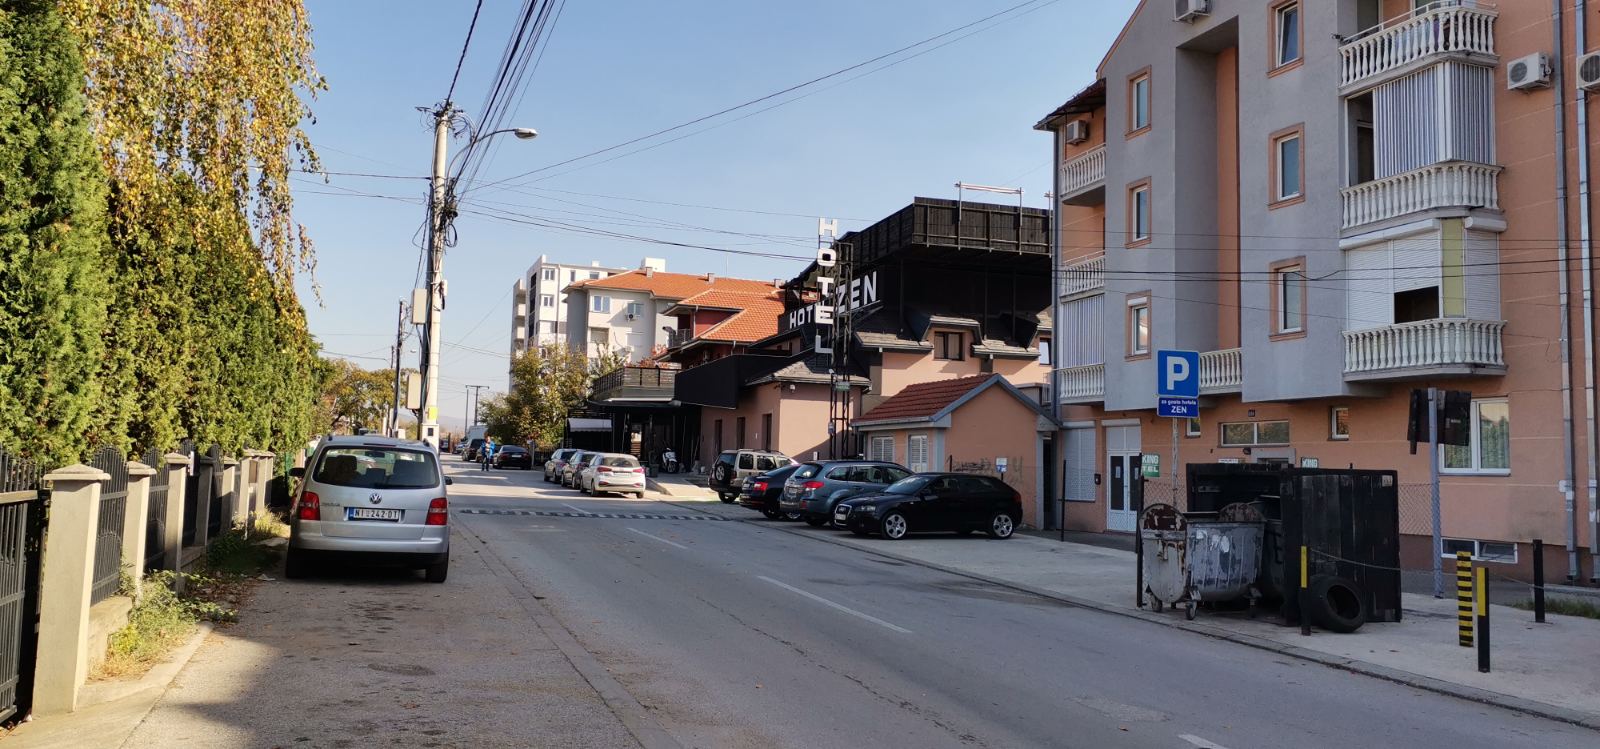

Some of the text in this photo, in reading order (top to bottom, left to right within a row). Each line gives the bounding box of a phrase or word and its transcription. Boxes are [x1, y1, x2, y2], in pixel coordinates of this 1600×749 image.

[815, 218, 838, 354] HOTEL
[836, 271, 877, 315] ZEN
[1167, 356, 1190, 390] P
[1171, 405, 1187, 414] ZEN
